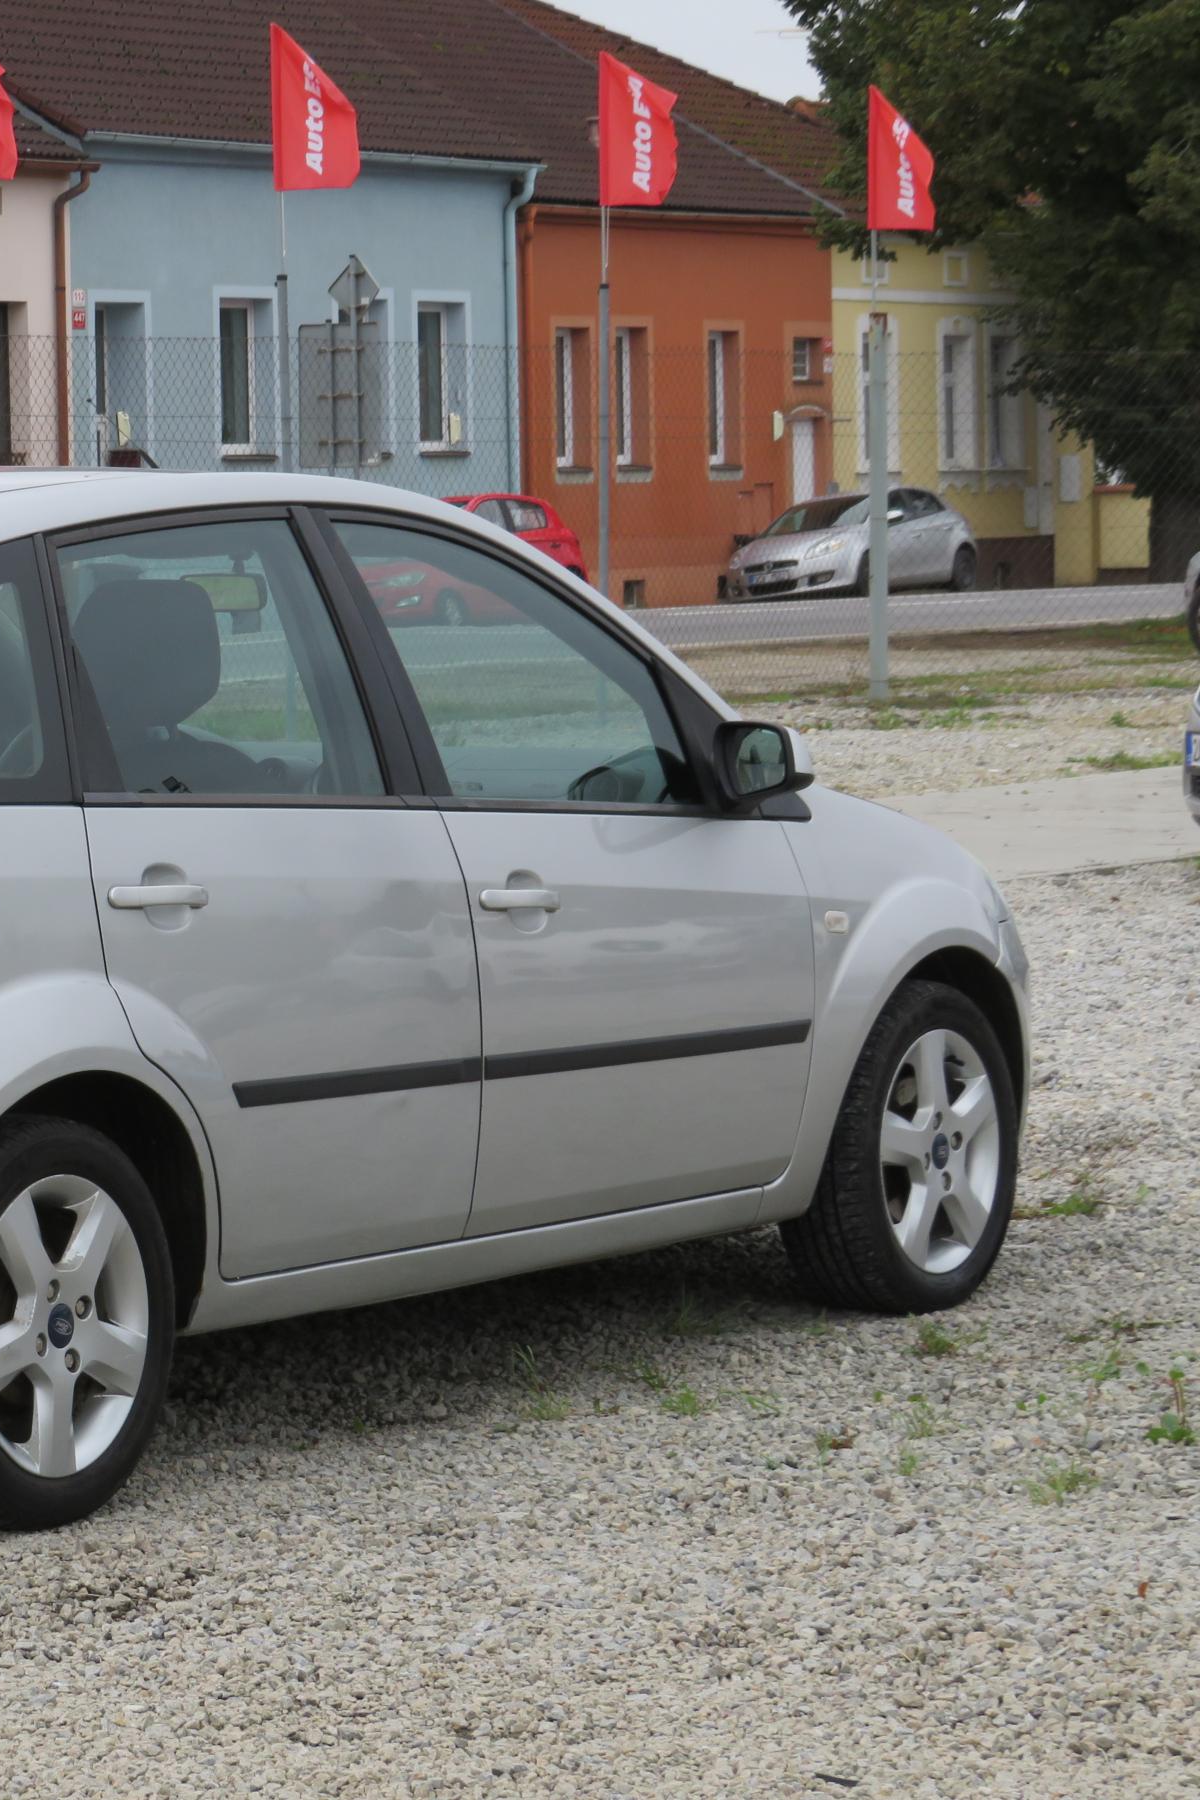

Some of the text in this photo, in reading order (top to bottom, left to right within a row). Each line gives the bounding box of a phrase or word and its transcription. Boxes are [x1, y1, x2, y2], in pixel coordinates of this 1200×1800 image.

[305, 97, 324, 176] Auto
[628, 75, 652, 193] Auto EA
